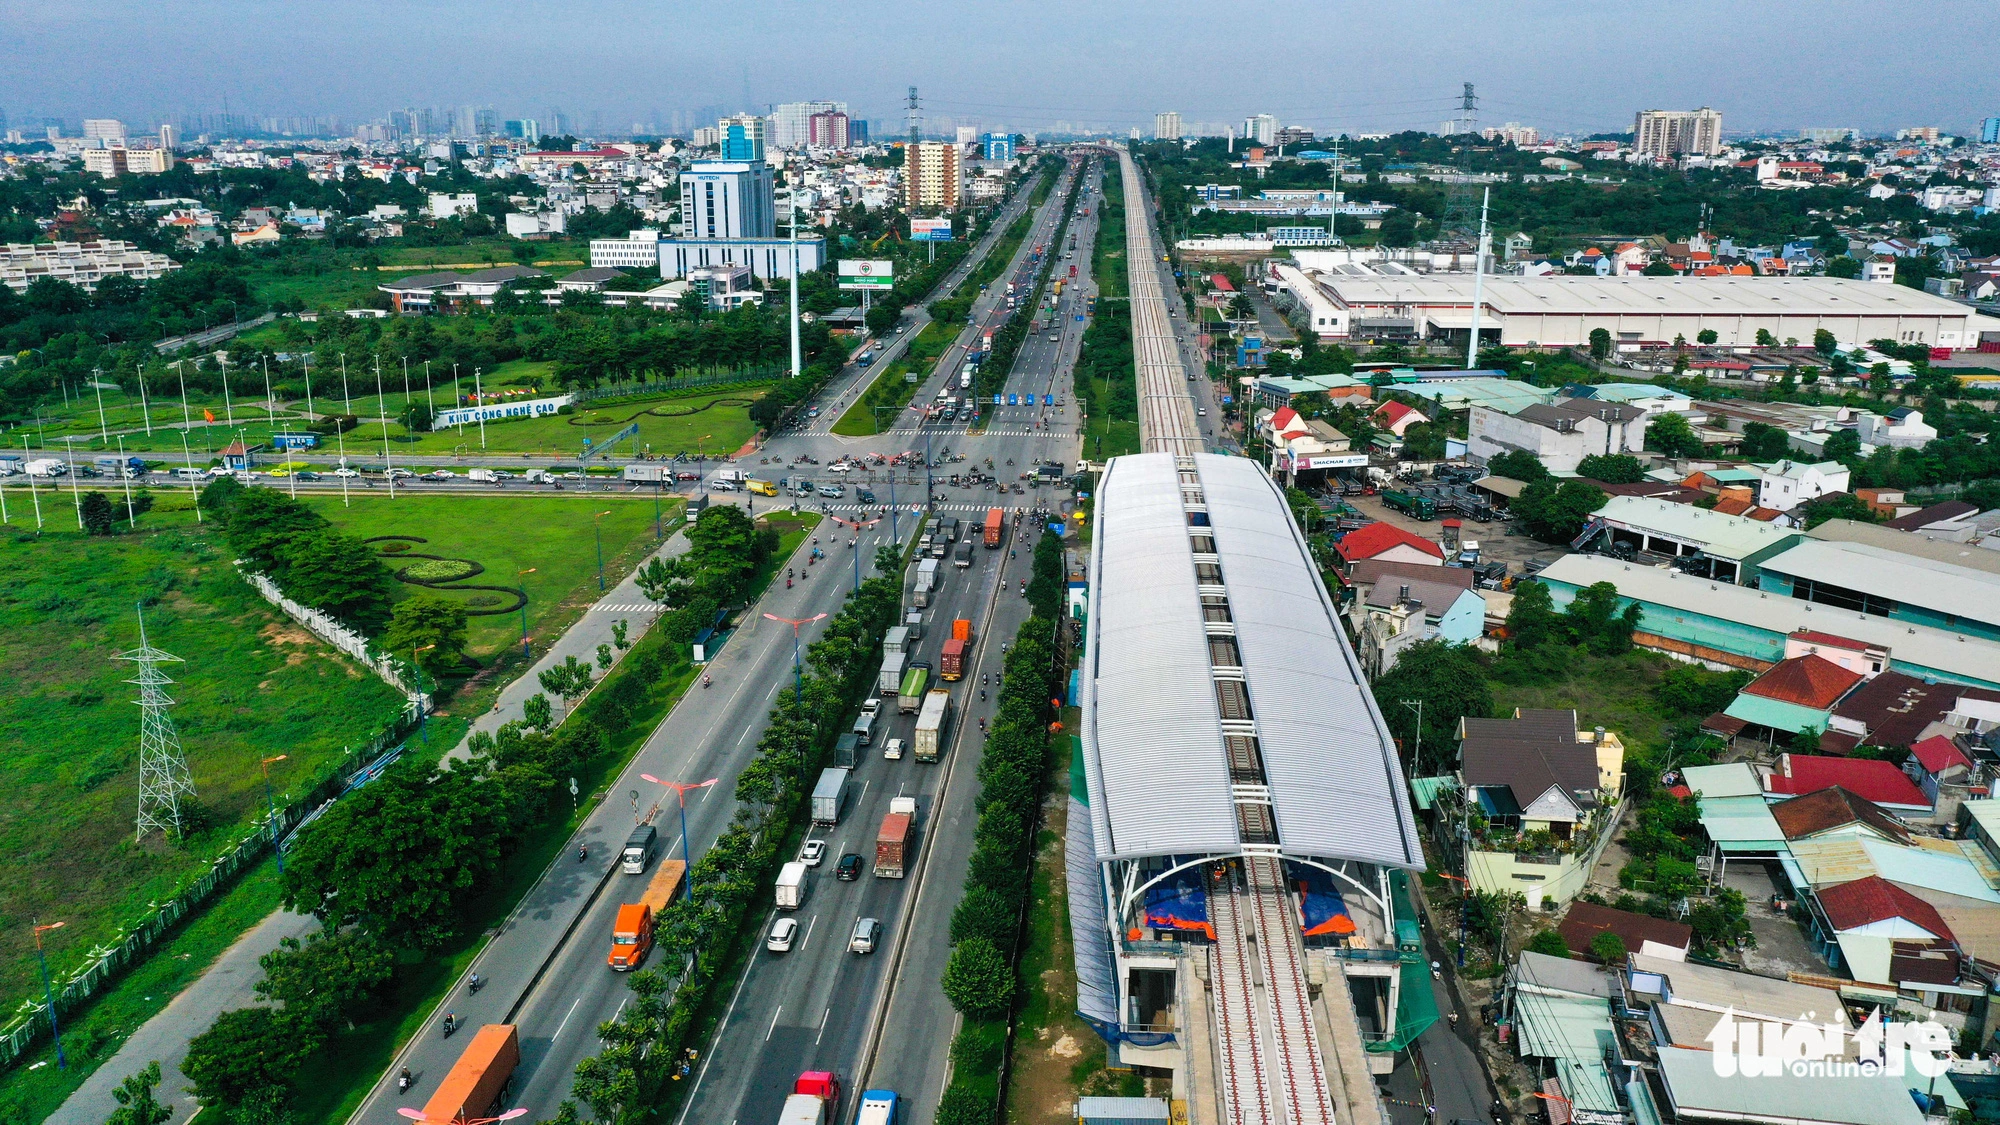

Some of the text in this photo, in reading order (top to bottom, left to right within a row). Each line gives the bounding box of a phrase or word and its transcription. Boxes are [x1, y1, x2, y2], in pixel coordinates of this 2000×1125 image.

[448, 413, 469, 424] KHU
[474, 409, 503, 420] CÔNG
[536, 403, 554, 413] CAO
